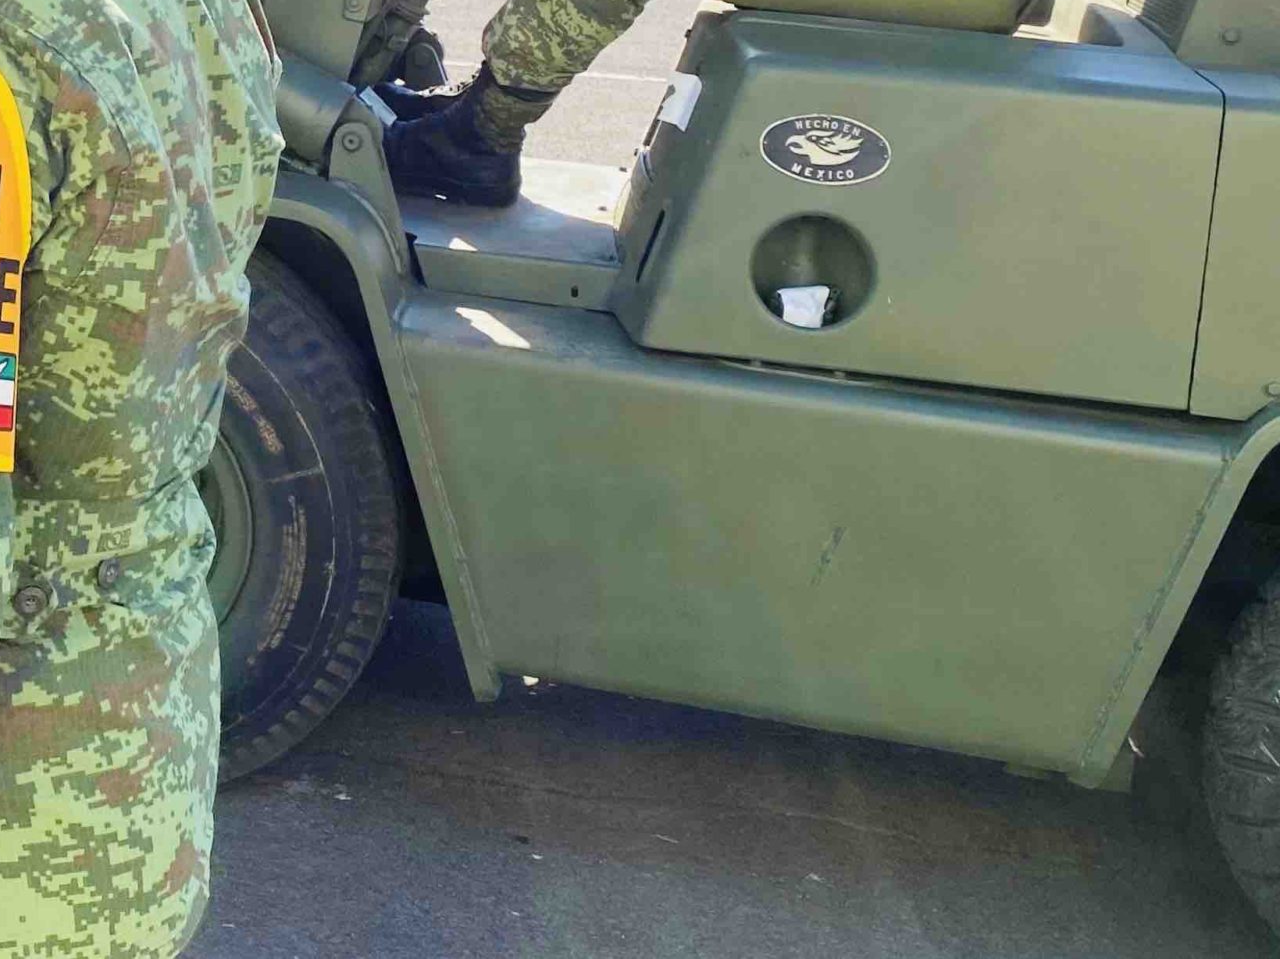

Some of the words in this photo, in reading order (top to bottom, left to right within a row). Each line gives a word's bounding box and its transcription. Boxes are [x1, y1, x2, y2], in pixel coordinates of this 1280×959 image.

[794, 119, 838, 130] HECHO
[843, 123, 862, 137] EN
[791, 163, 855, 181] MEXICO
